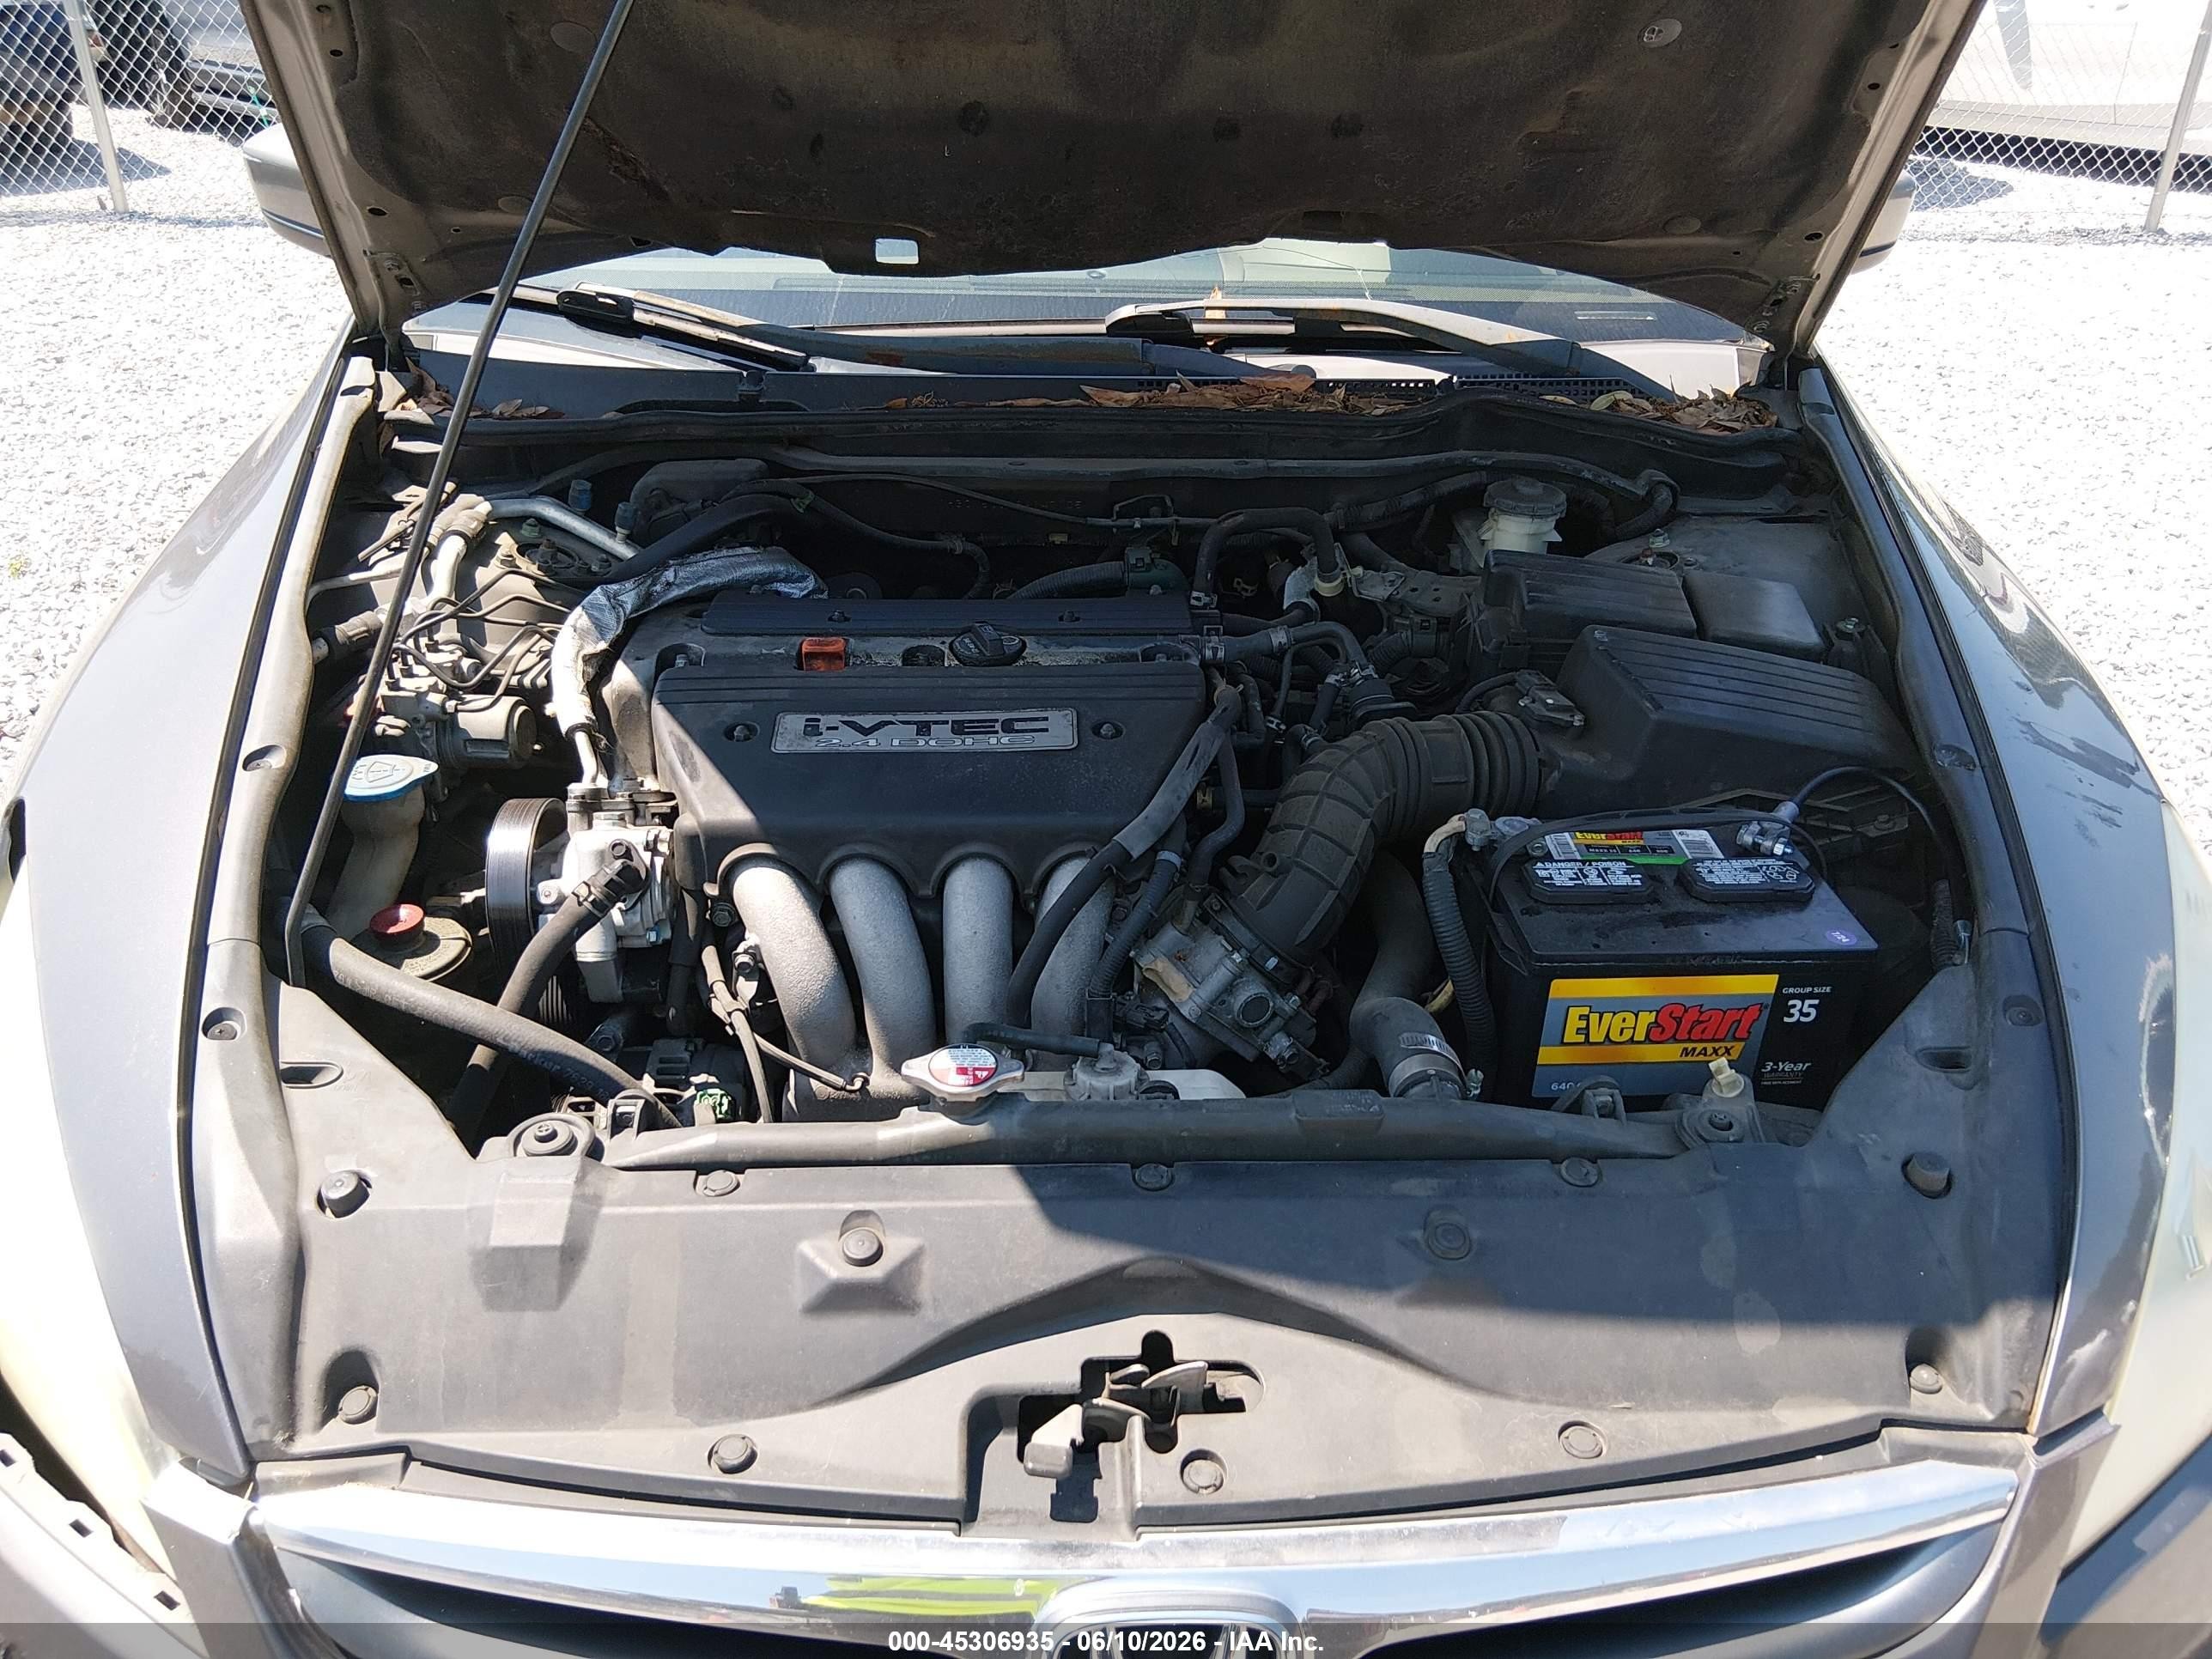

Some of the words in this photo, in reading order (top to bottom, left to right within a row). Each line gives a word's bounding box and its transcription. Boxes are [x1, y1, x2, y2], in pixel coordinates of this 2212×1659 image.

[803, 716, 1048, 737] i-VTEC
[816, 738, 880, 747] 2.4
[890, 735, 1035, 746] DOHC
[1783, 999, 1820, 1023] 35
[1563, 1002, 1764, 1043] EverStart
[1680, 1045, 1735, 1058] MAXX
[1761, 1061, 1812, 1073] 3-Year
